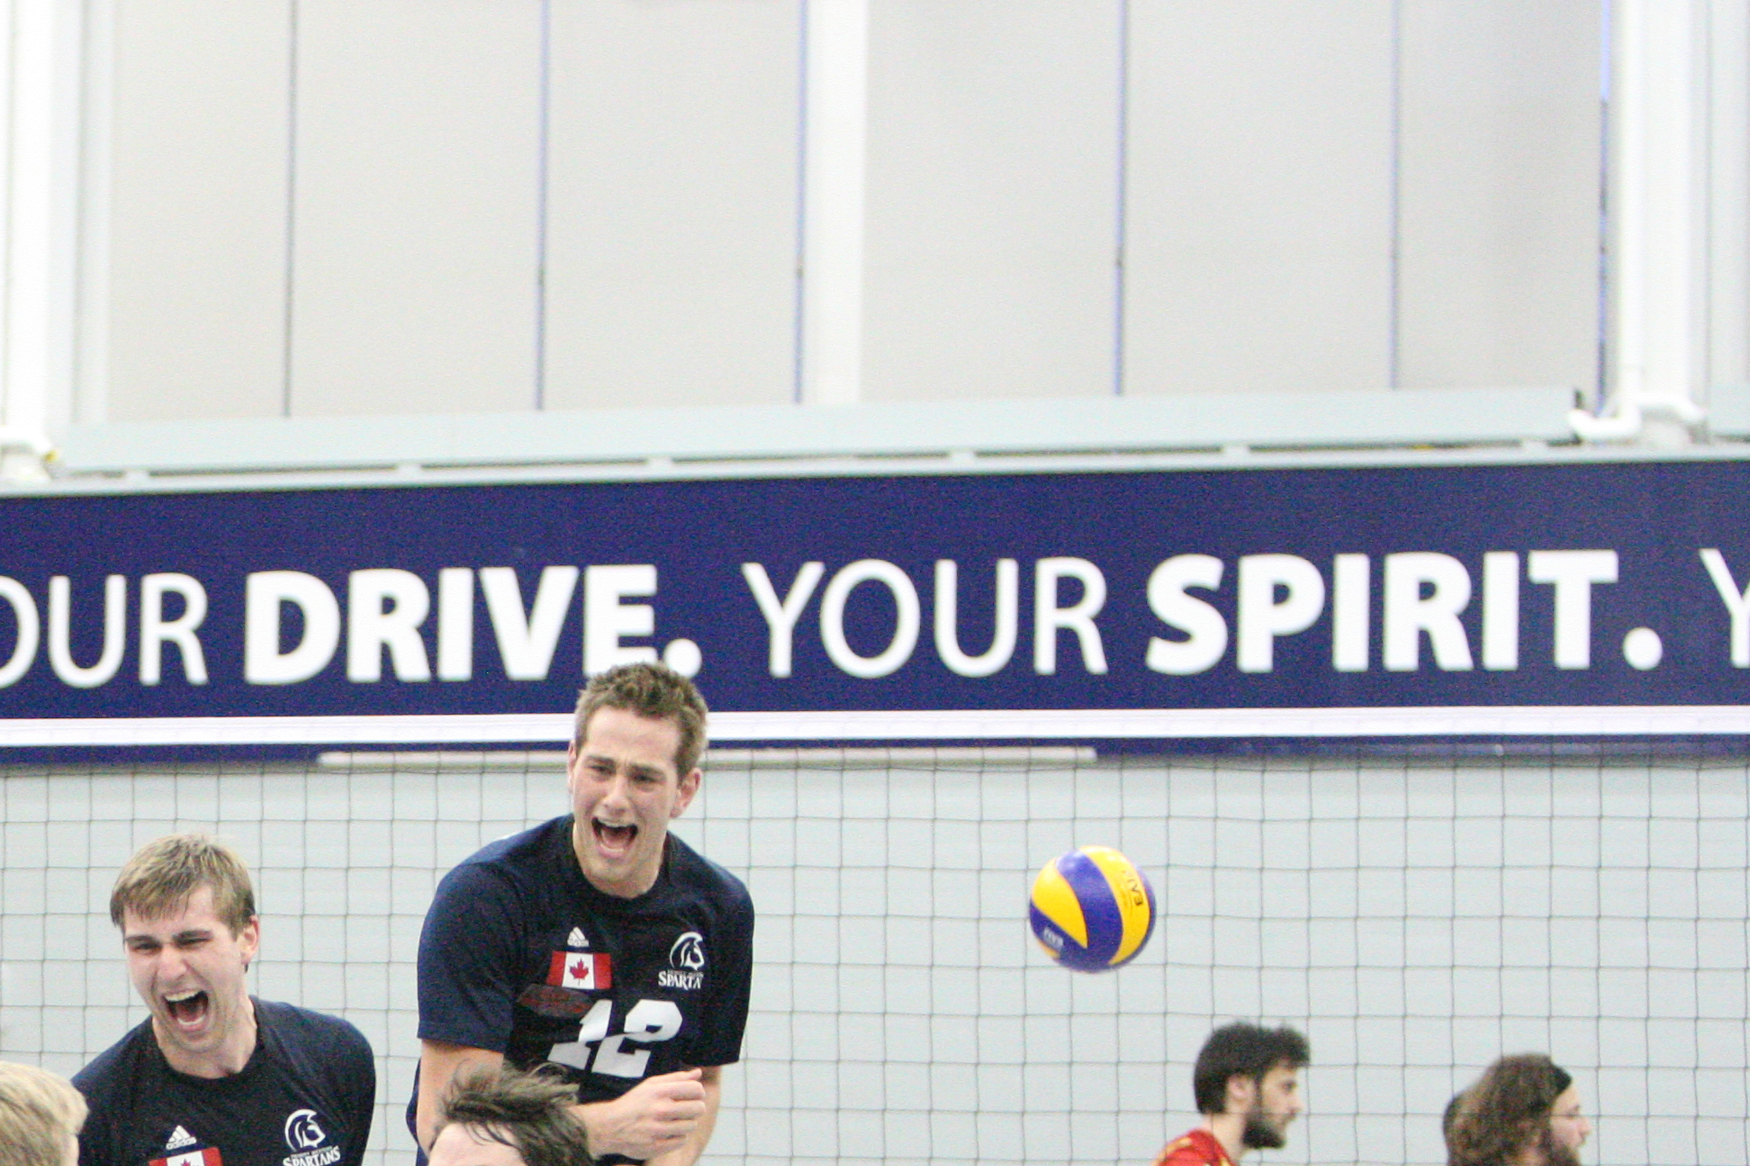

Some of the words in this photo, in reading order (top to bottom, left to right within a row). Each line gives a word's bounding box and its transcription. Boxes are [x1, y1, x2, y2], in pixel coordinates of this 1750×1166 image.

[244, 564, 702, 685] DRIVE.
[741, 555, 1109, 679] YOUR
[1144, 549, 1663, 676] SPIRIT.
[547, 999, 683, 1078] 12
